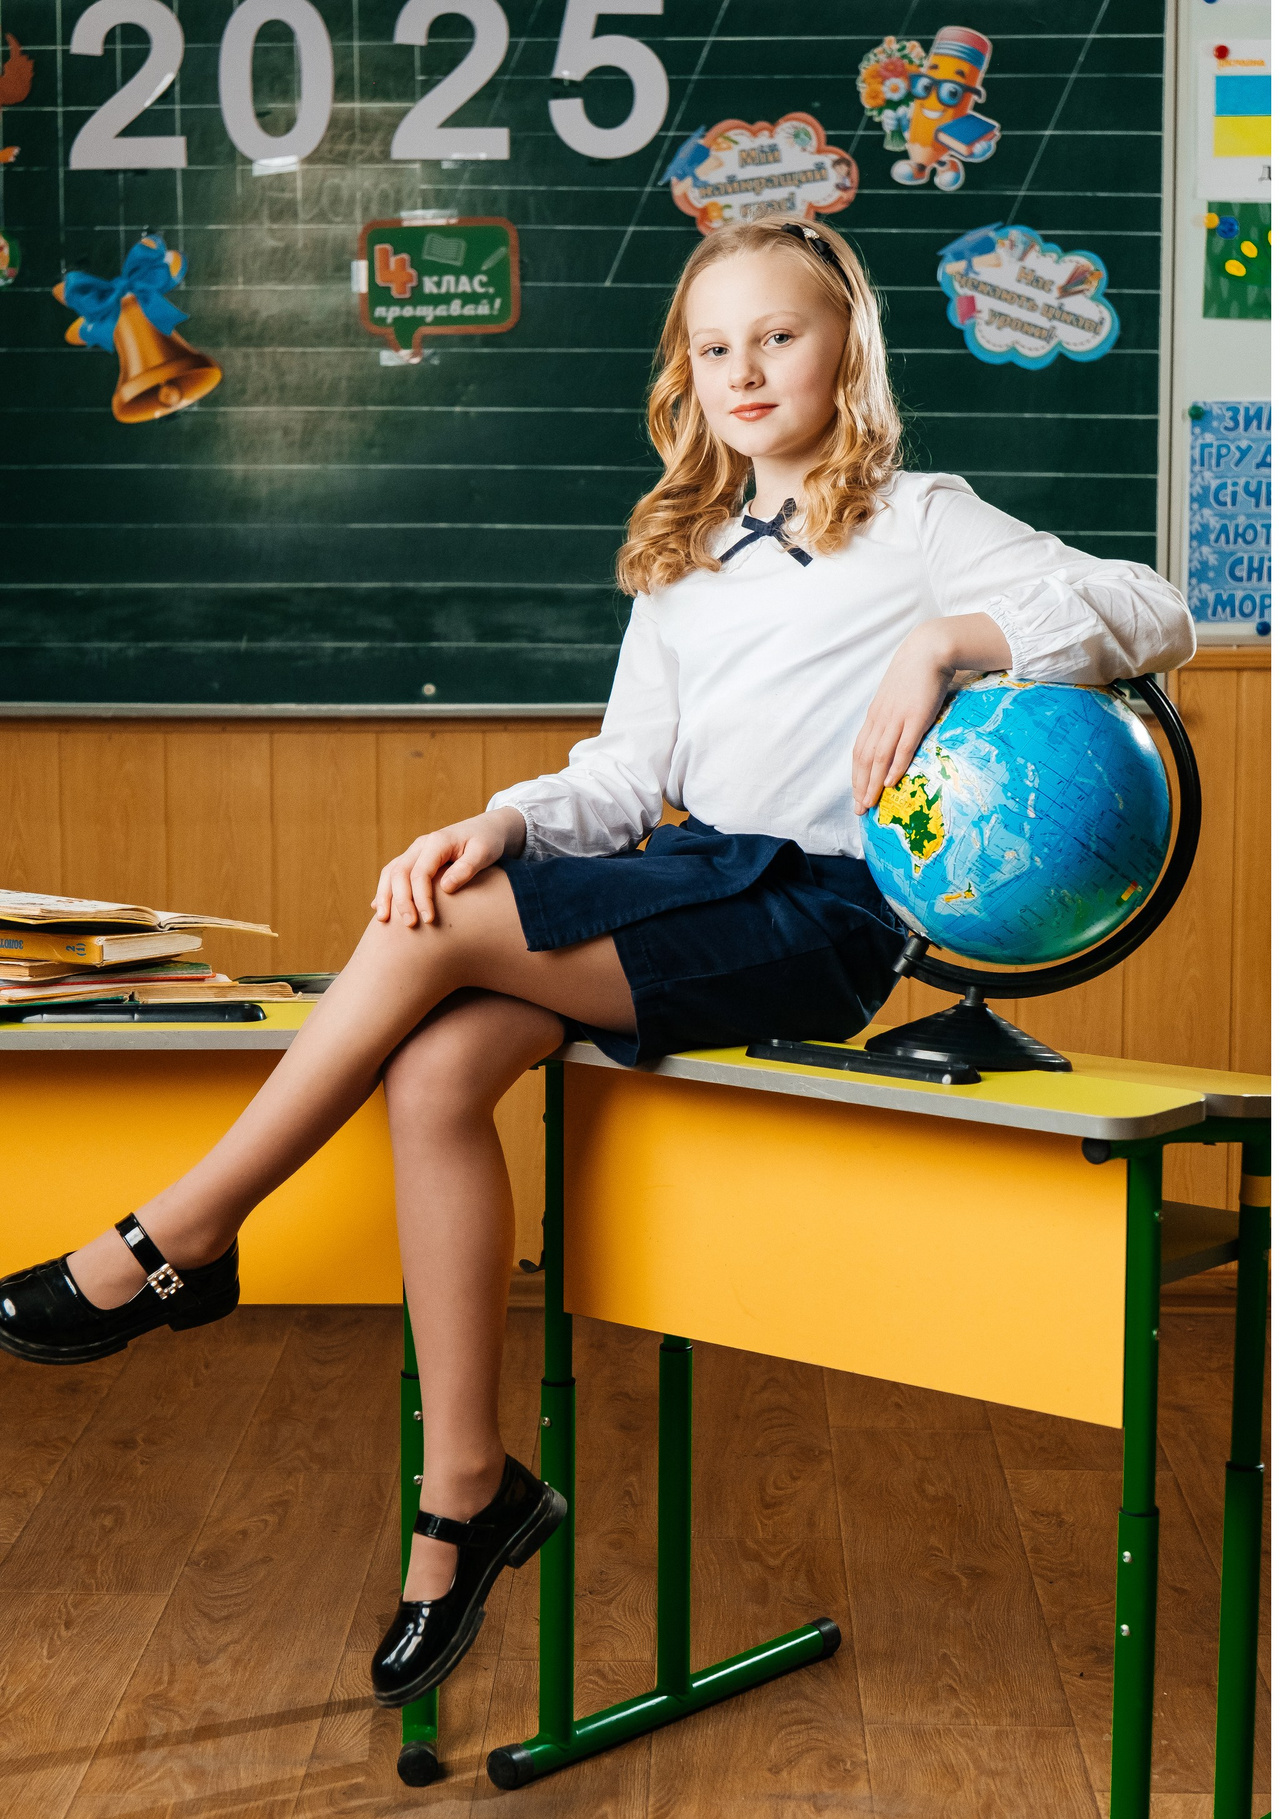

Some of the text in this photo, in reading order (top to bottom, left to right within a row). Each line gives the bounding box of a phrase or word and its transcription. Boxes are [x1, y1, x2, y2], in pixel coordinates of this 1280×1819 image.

[69, 0, 670, 170] 2025
[374, 244, 495, 298] 4 КЛАС,
[1014, 265, 1055, 294] Нас
[374, 298, 502, 324] прощавай!
[953, 271, 1106, 337] чекають цікаві
[985, 308, 1058, 344] уроки!
[1223, 405, 1271, 432] ЗИ
